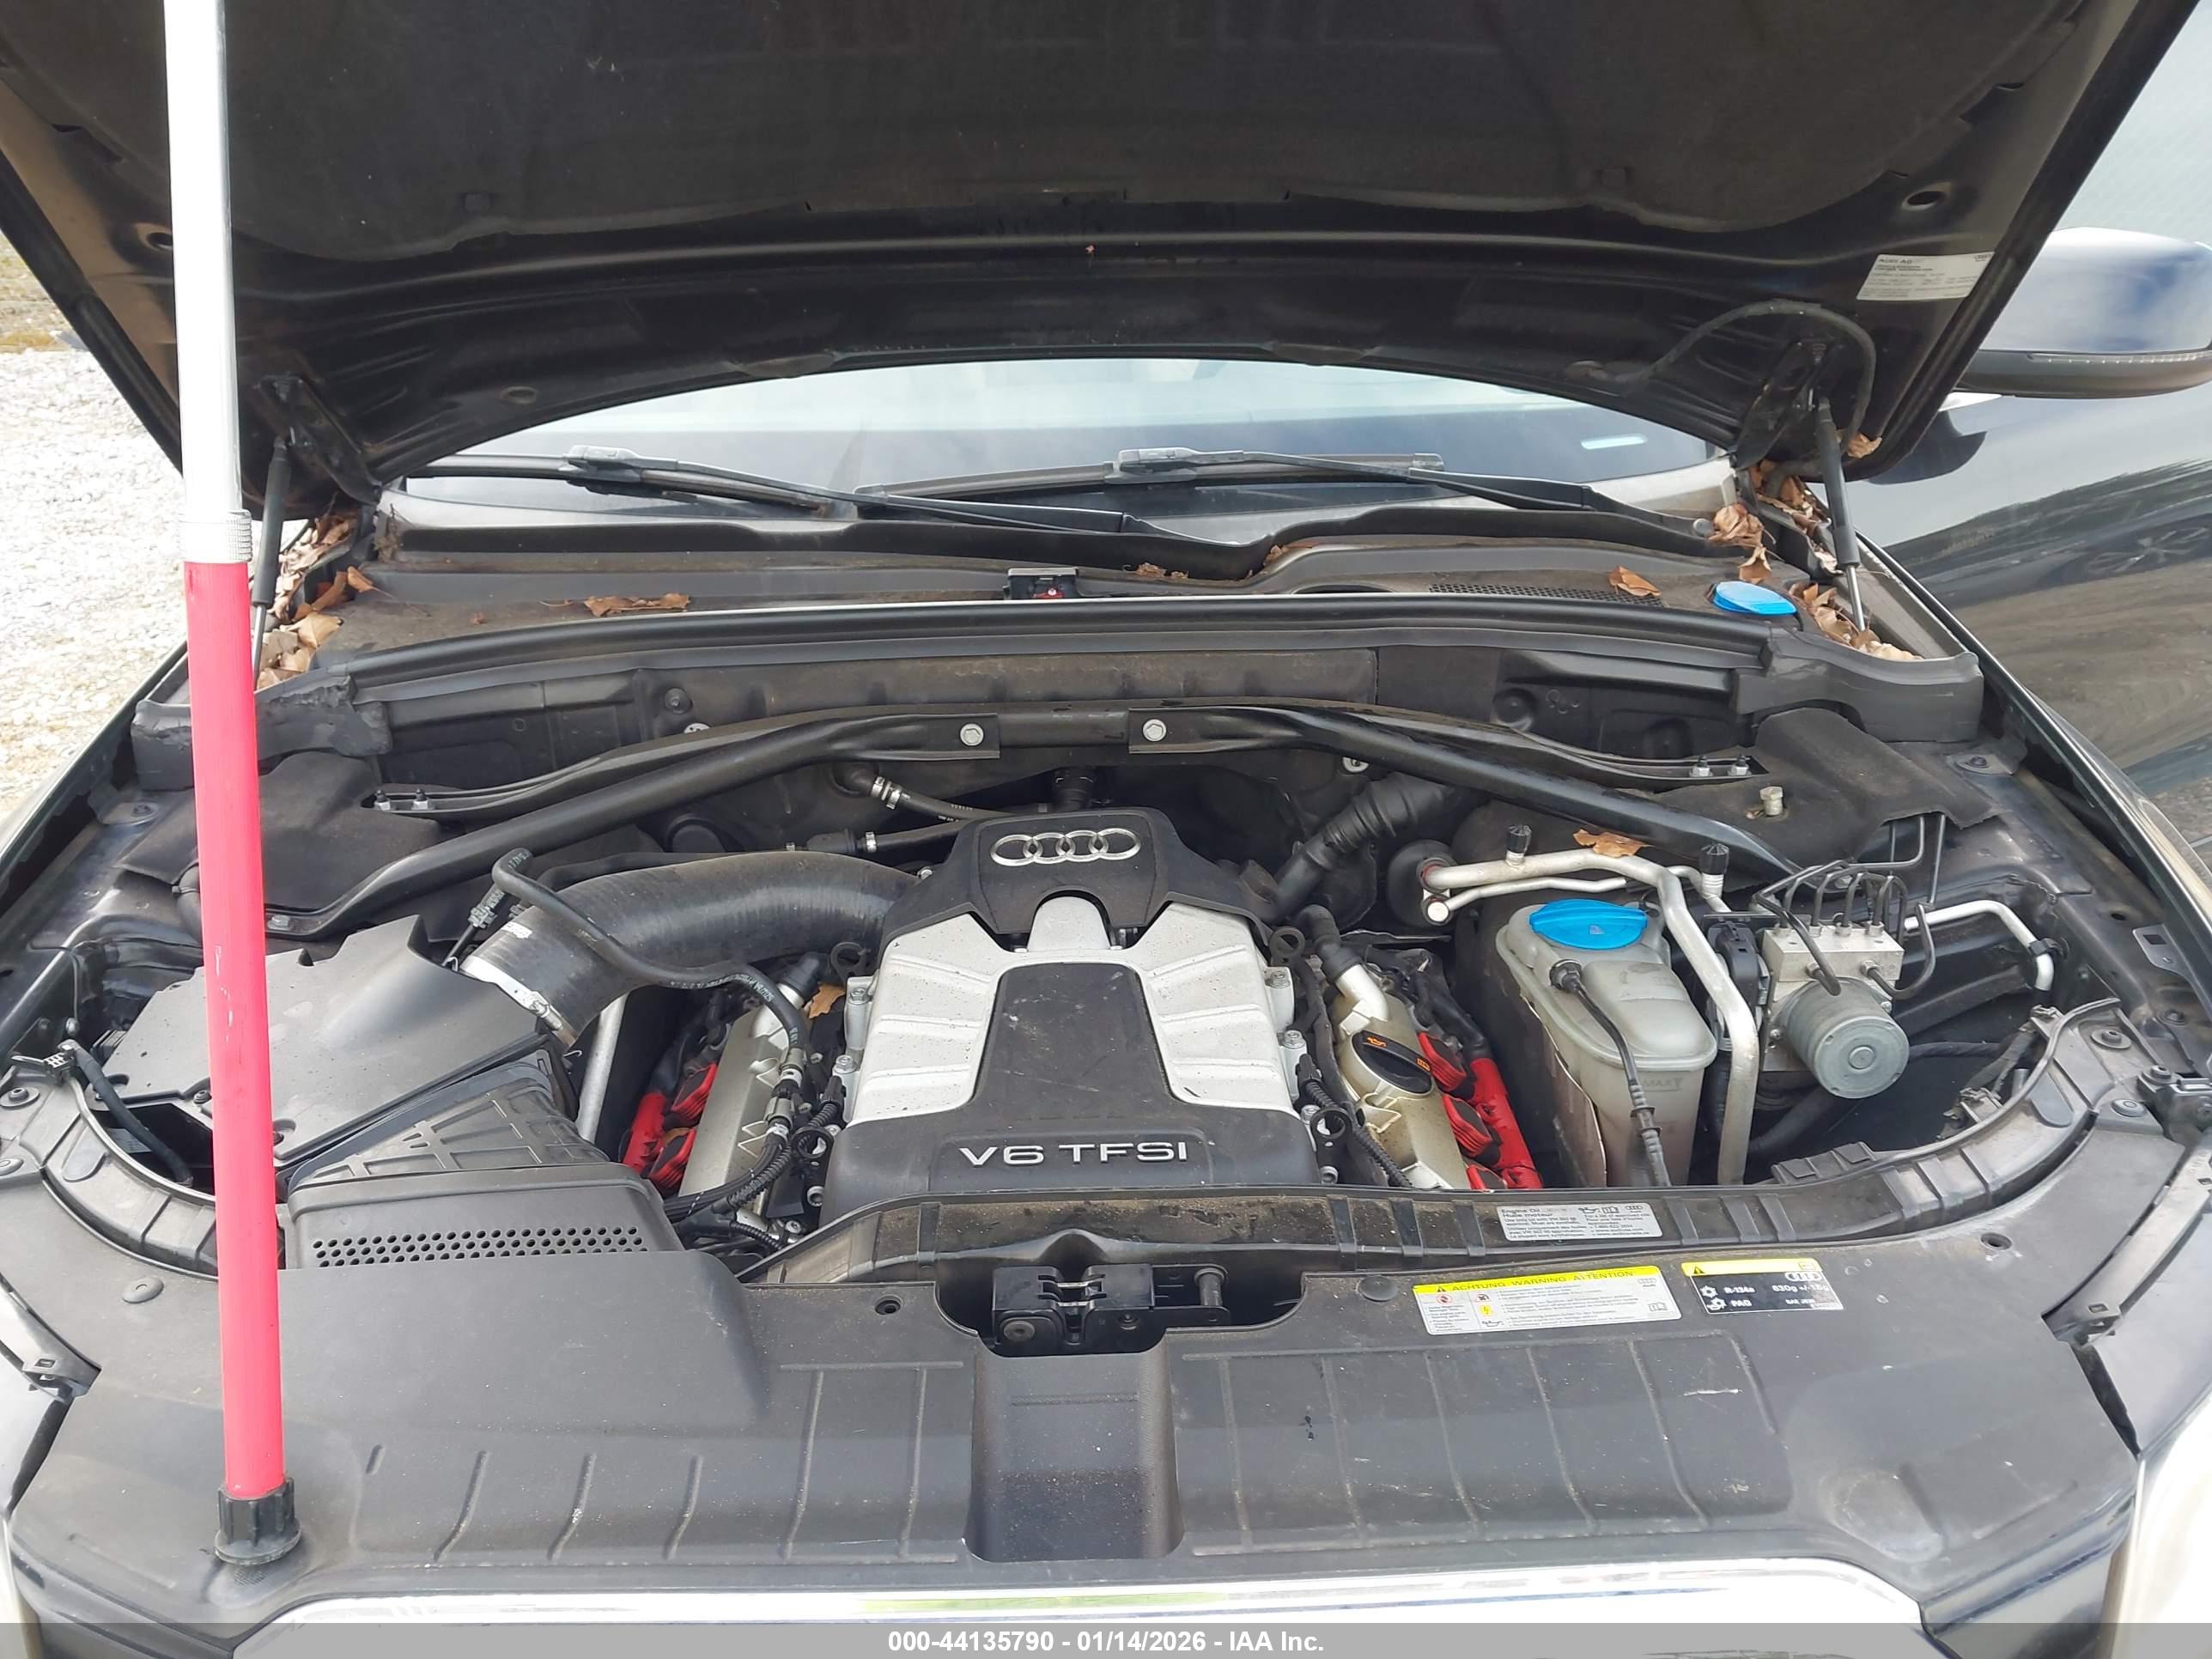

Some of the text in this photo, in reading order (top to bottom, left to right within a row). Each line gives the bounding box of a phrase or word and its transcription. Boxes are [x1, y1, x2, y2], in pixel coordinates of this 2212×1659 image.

[958, 1141, 1188, 1167] V6 TFSI
[1452, 1281, 1506, 1291] ACHTUNG
[1511, 1276, 1567, 1286] WARNING
[1573, 1271, 1634, 1281] ATTENTION
